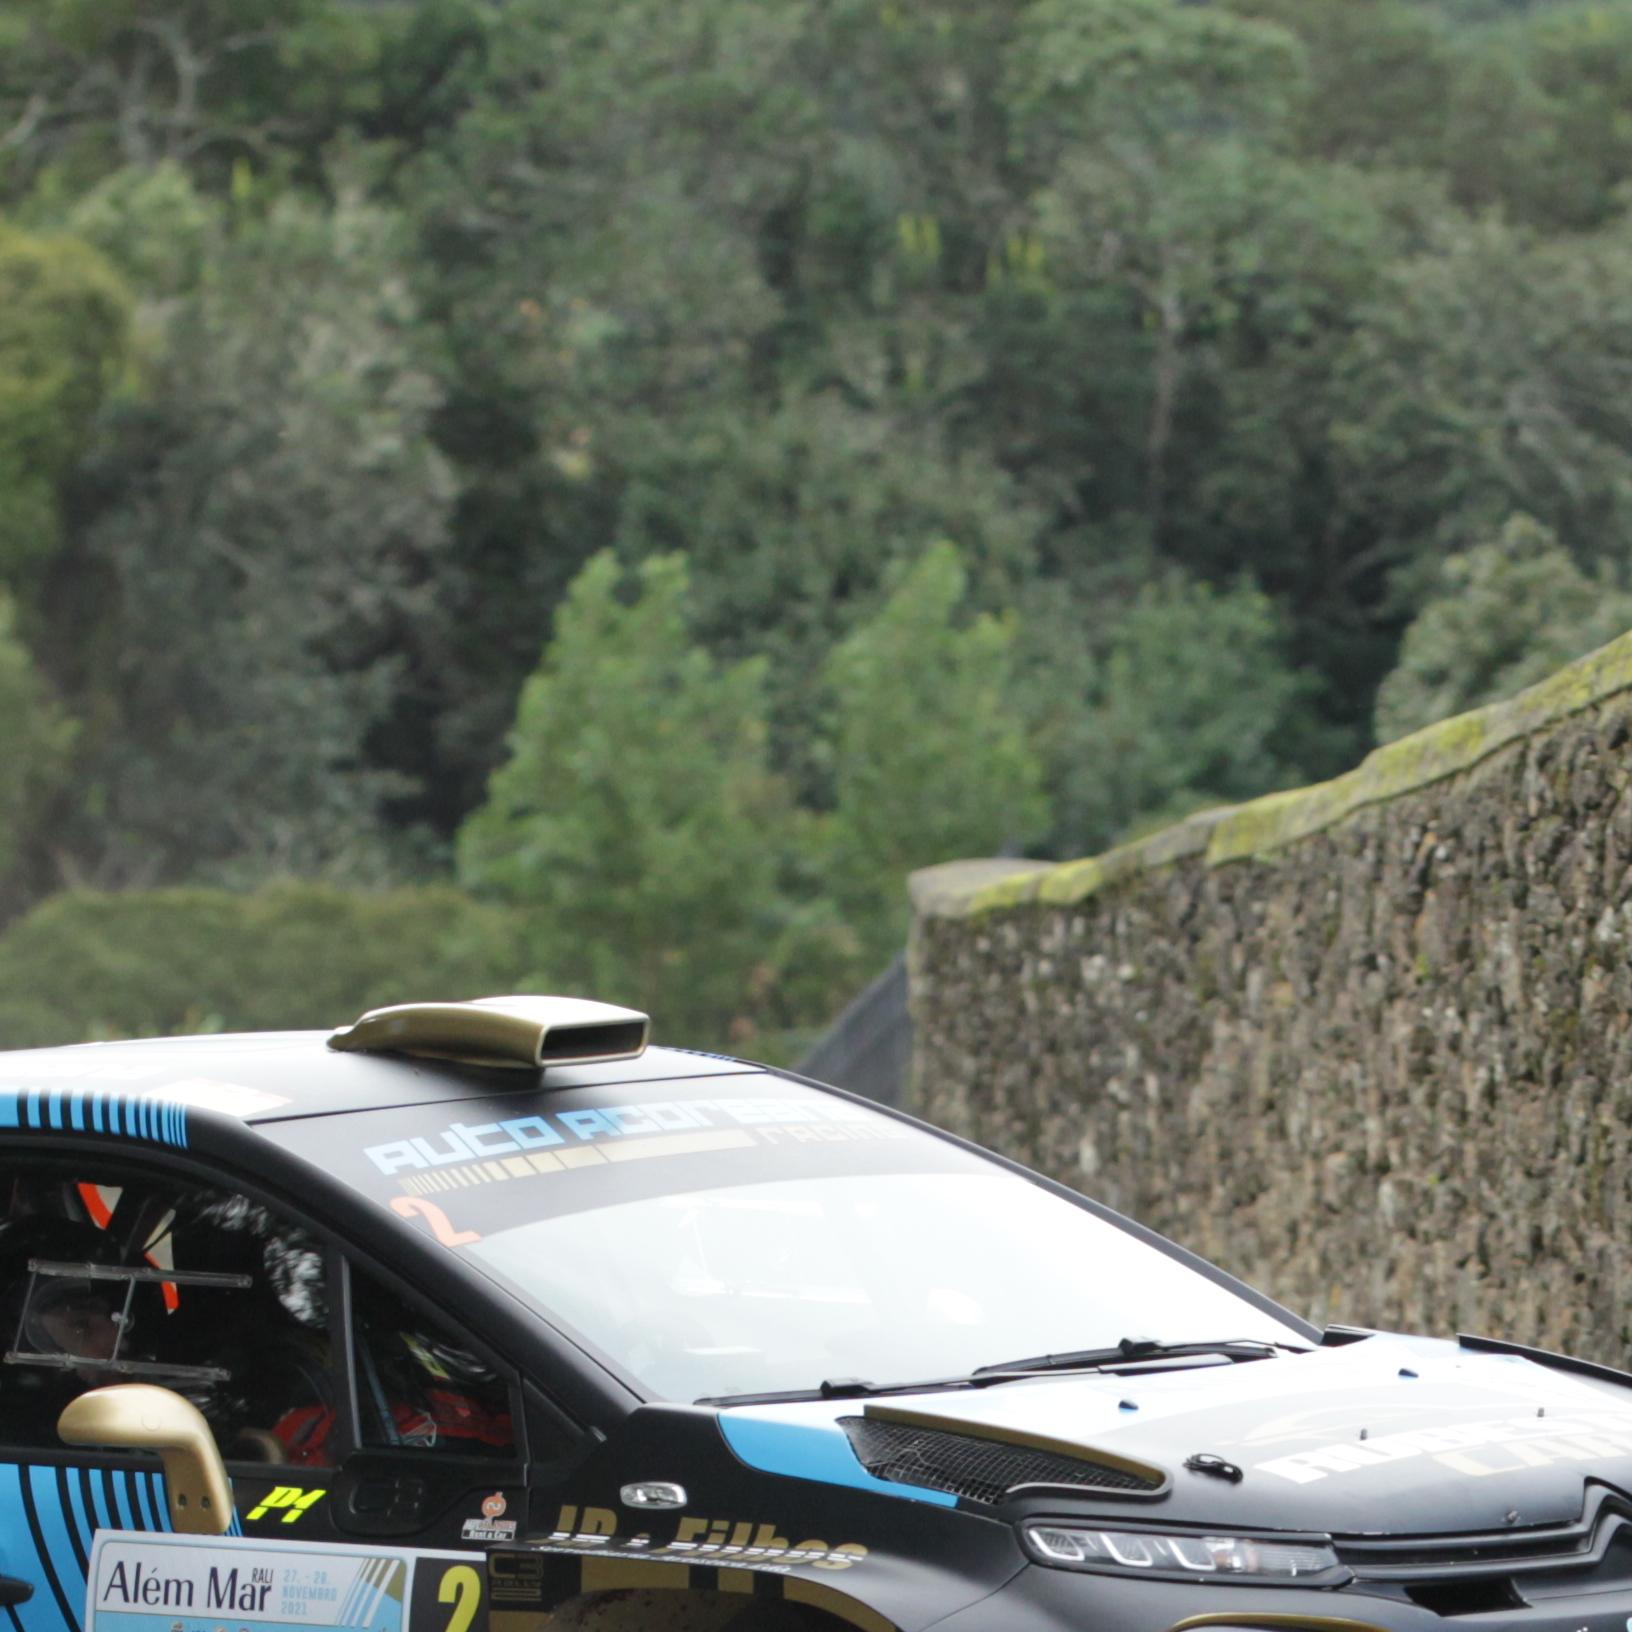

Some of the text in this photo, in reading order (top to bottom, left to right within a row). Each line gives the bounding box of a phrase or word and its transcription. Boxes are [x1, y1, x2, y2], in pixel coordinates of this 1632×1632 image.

[388, 1196, 482, 1248] 2
[648, 1516, 868, 1570] Filhos
[103, 1560, 272, 1611] Além Mar
[251, 1567, 274, 1584] RALI
[282, 1584, 337, 1602] NOVEMBRO
